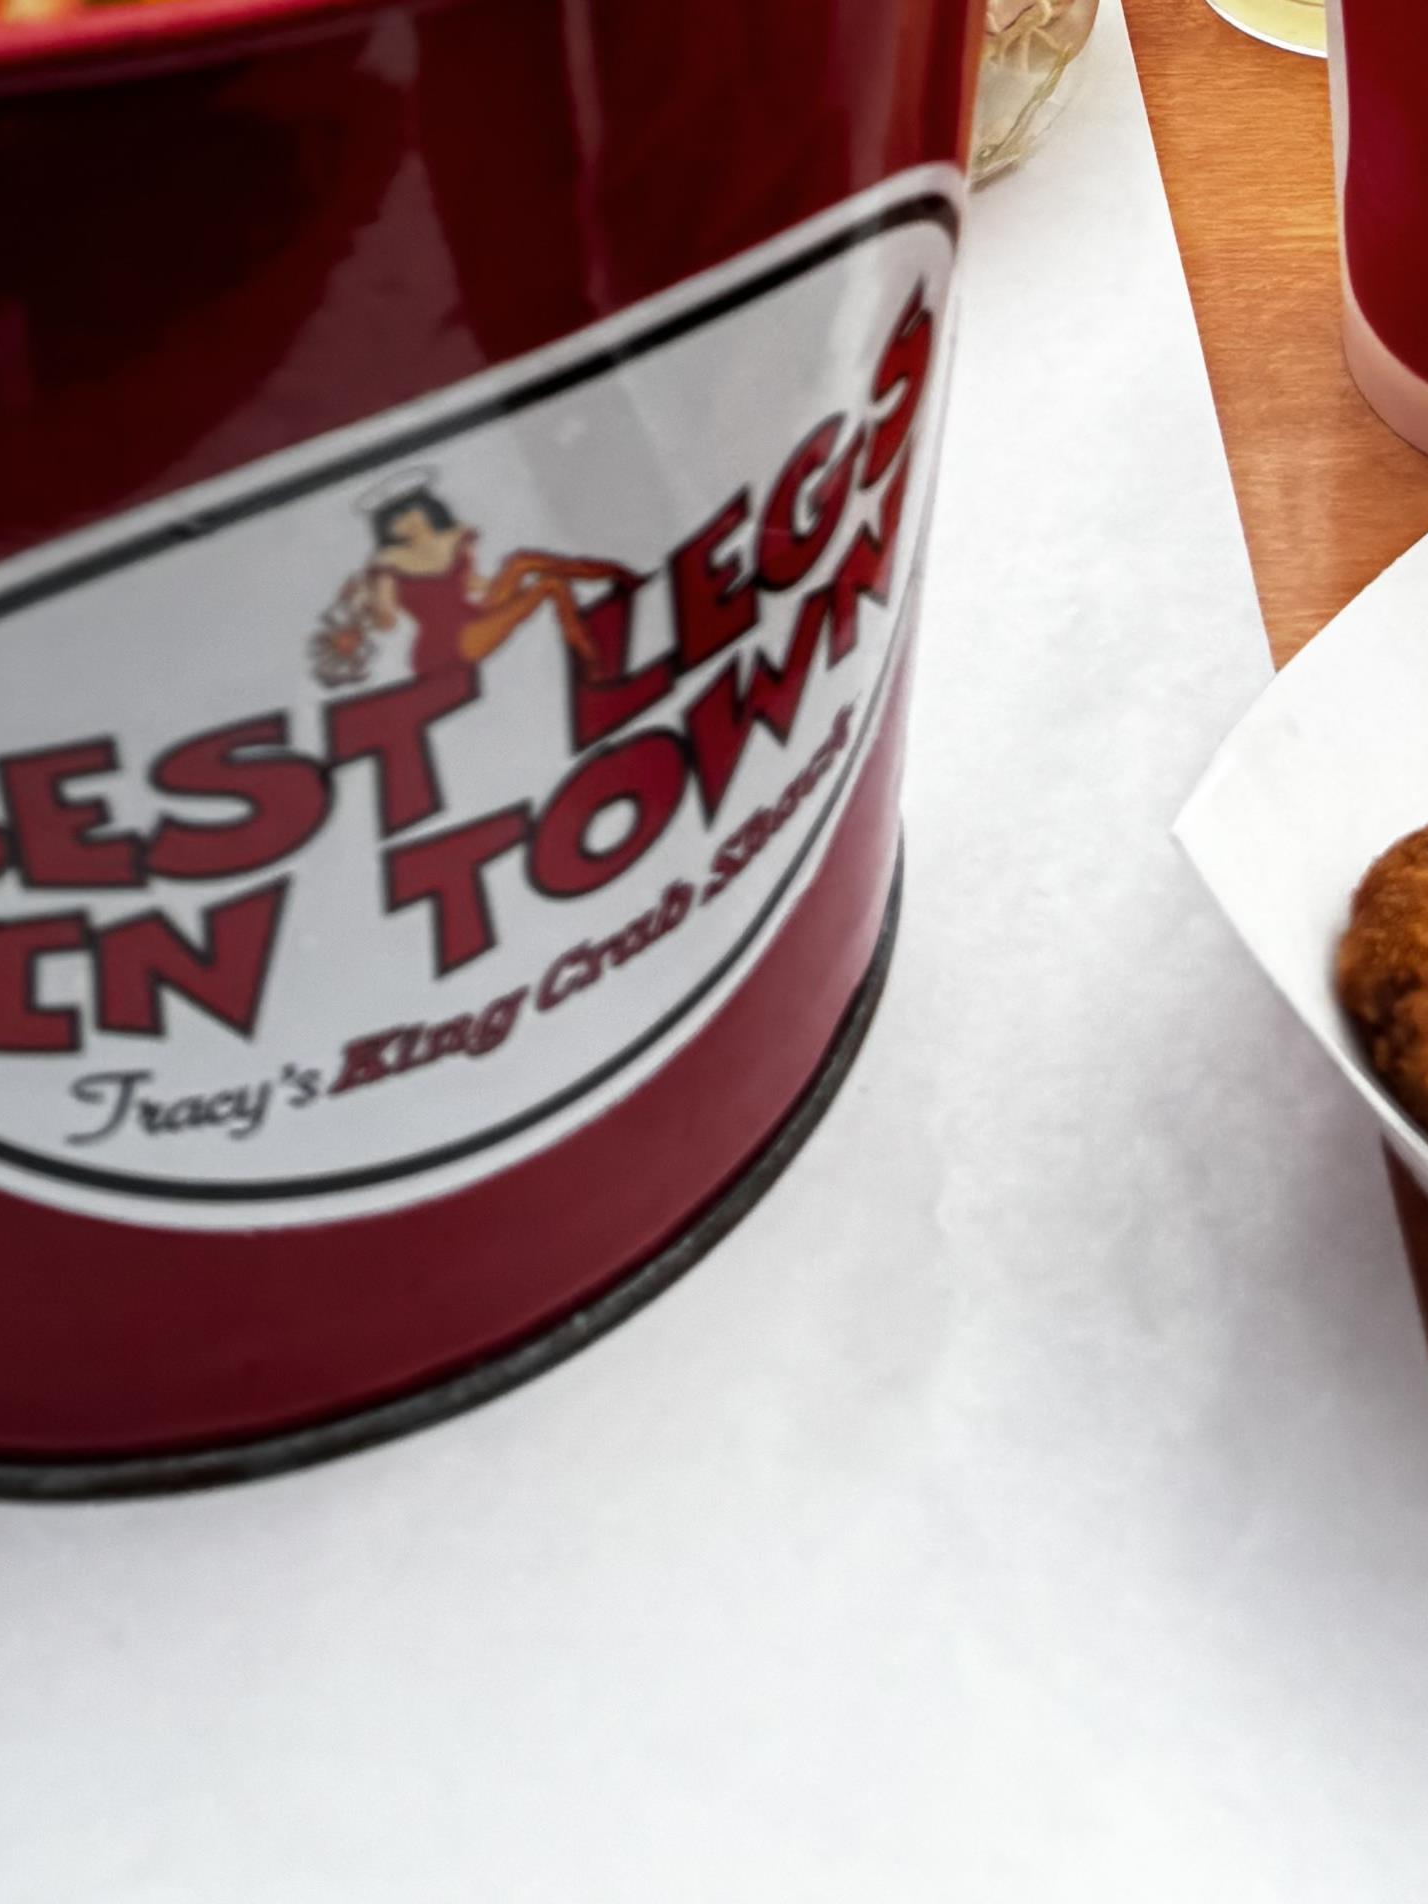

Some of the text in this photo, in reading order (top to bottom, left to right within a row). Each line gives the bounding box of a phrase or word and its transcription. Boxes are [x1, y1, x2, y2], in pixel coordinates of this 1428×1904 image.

[382, 432, 912, 980] TOWN
[569, 275, 934, 759] LEGS
[64, 1062, 324, 1146] Tracy's
[327, 984, 530, 1096] King
[532, 879, 694, 1015] Crab
